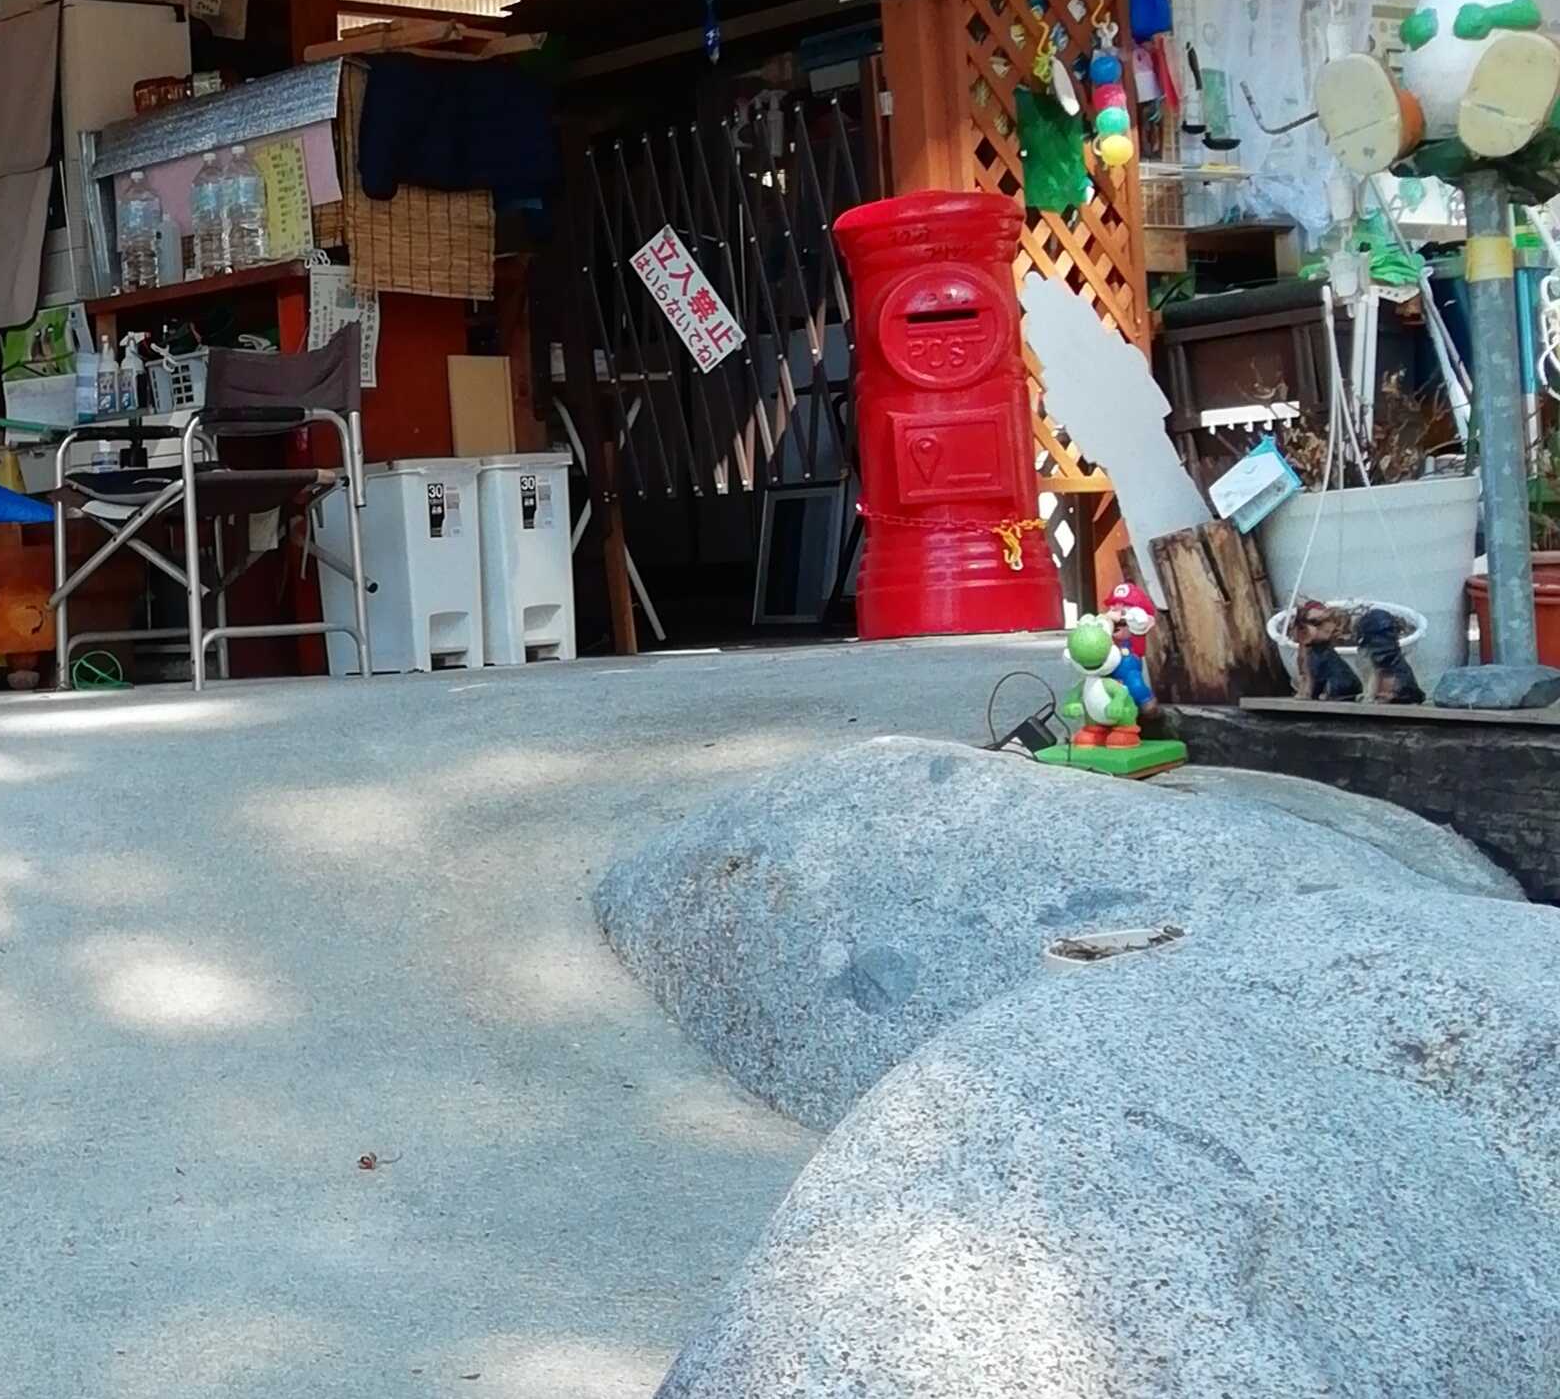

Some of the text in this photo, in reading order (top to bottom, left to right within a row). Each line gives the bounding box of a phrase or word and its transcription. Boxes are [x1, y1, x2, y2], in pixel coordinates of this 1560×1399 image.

[648, 235, 734, 353] 立入禁止
[428, 484, 443, 498] 30
[521, 477, 535, 491] 30
